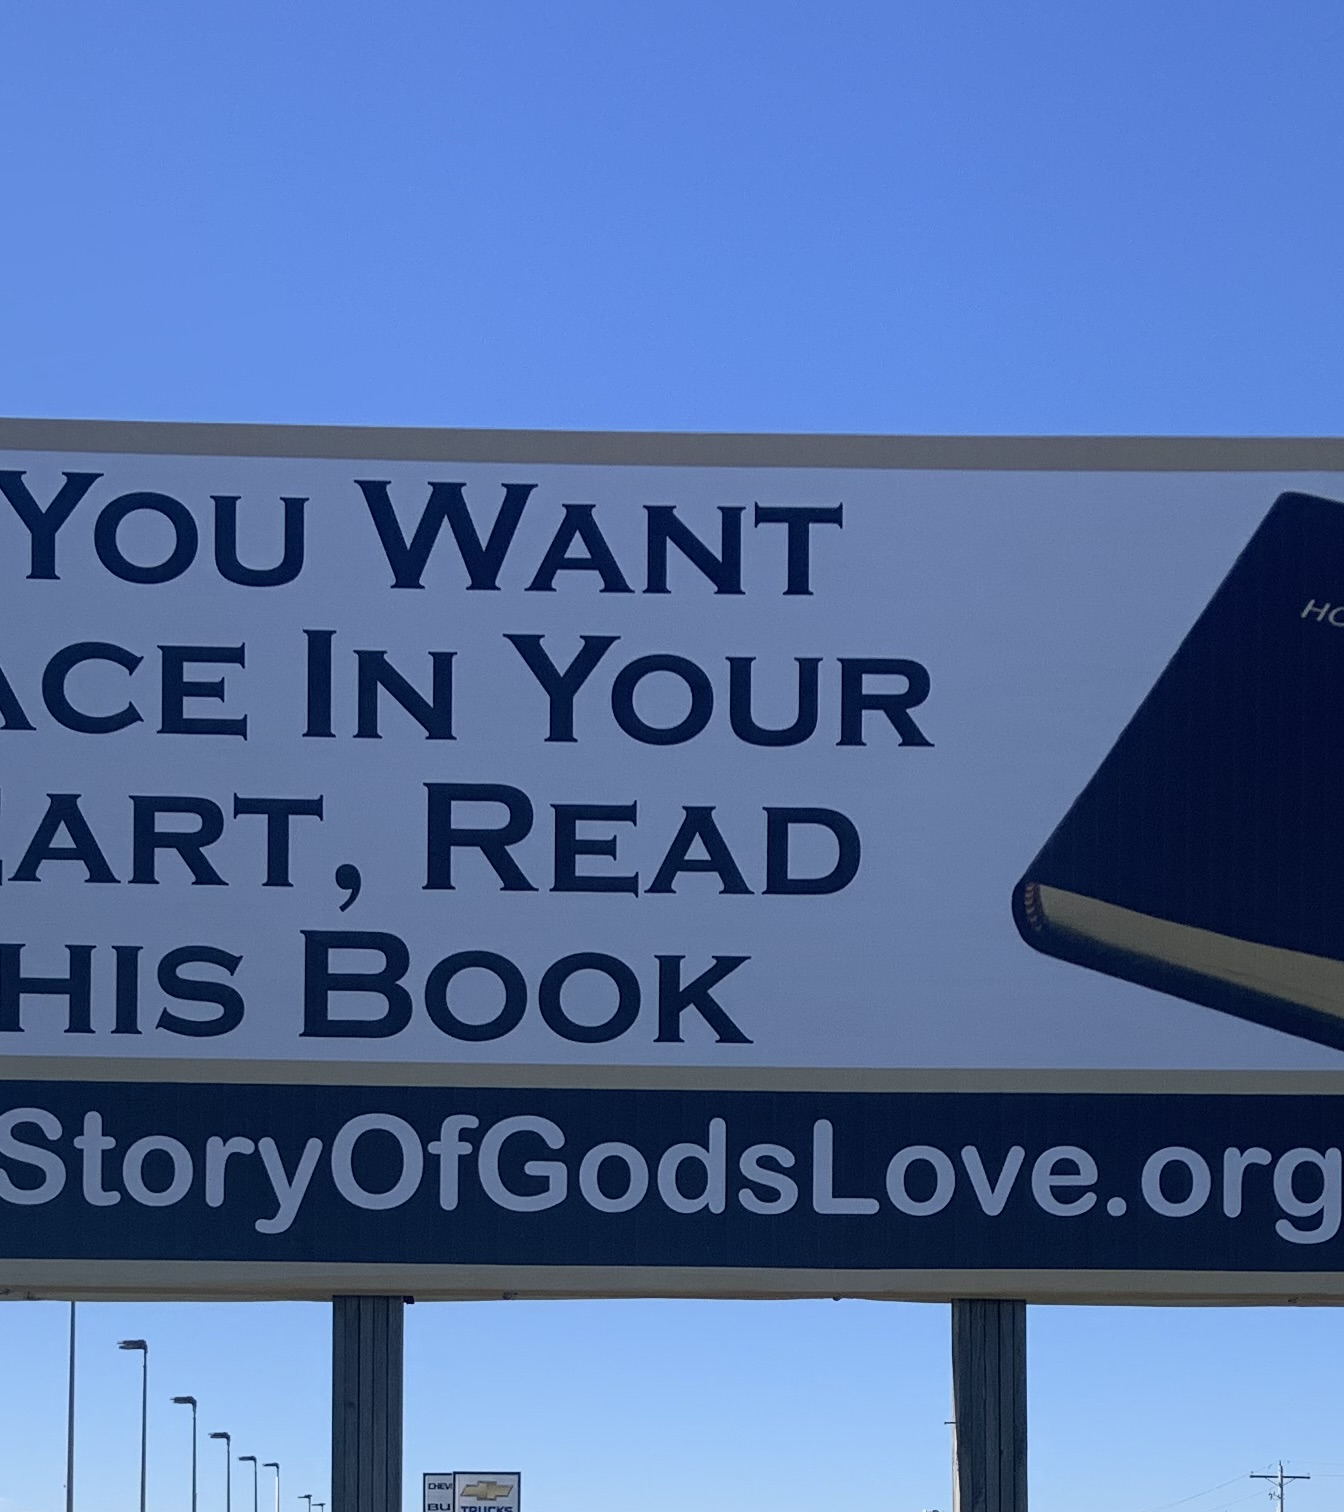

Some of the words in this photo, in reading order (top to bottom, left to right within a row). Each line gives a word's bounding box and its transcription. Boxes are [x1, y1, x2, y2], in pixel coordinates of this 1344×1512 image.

[353, 479, 844, 597] WANT
[301, 628, 458, 741] IN
[502, 633, 936, 748] YOUR
[421, 782, 863, 896] READ
[298, 929, 755, 1045] BOOK
